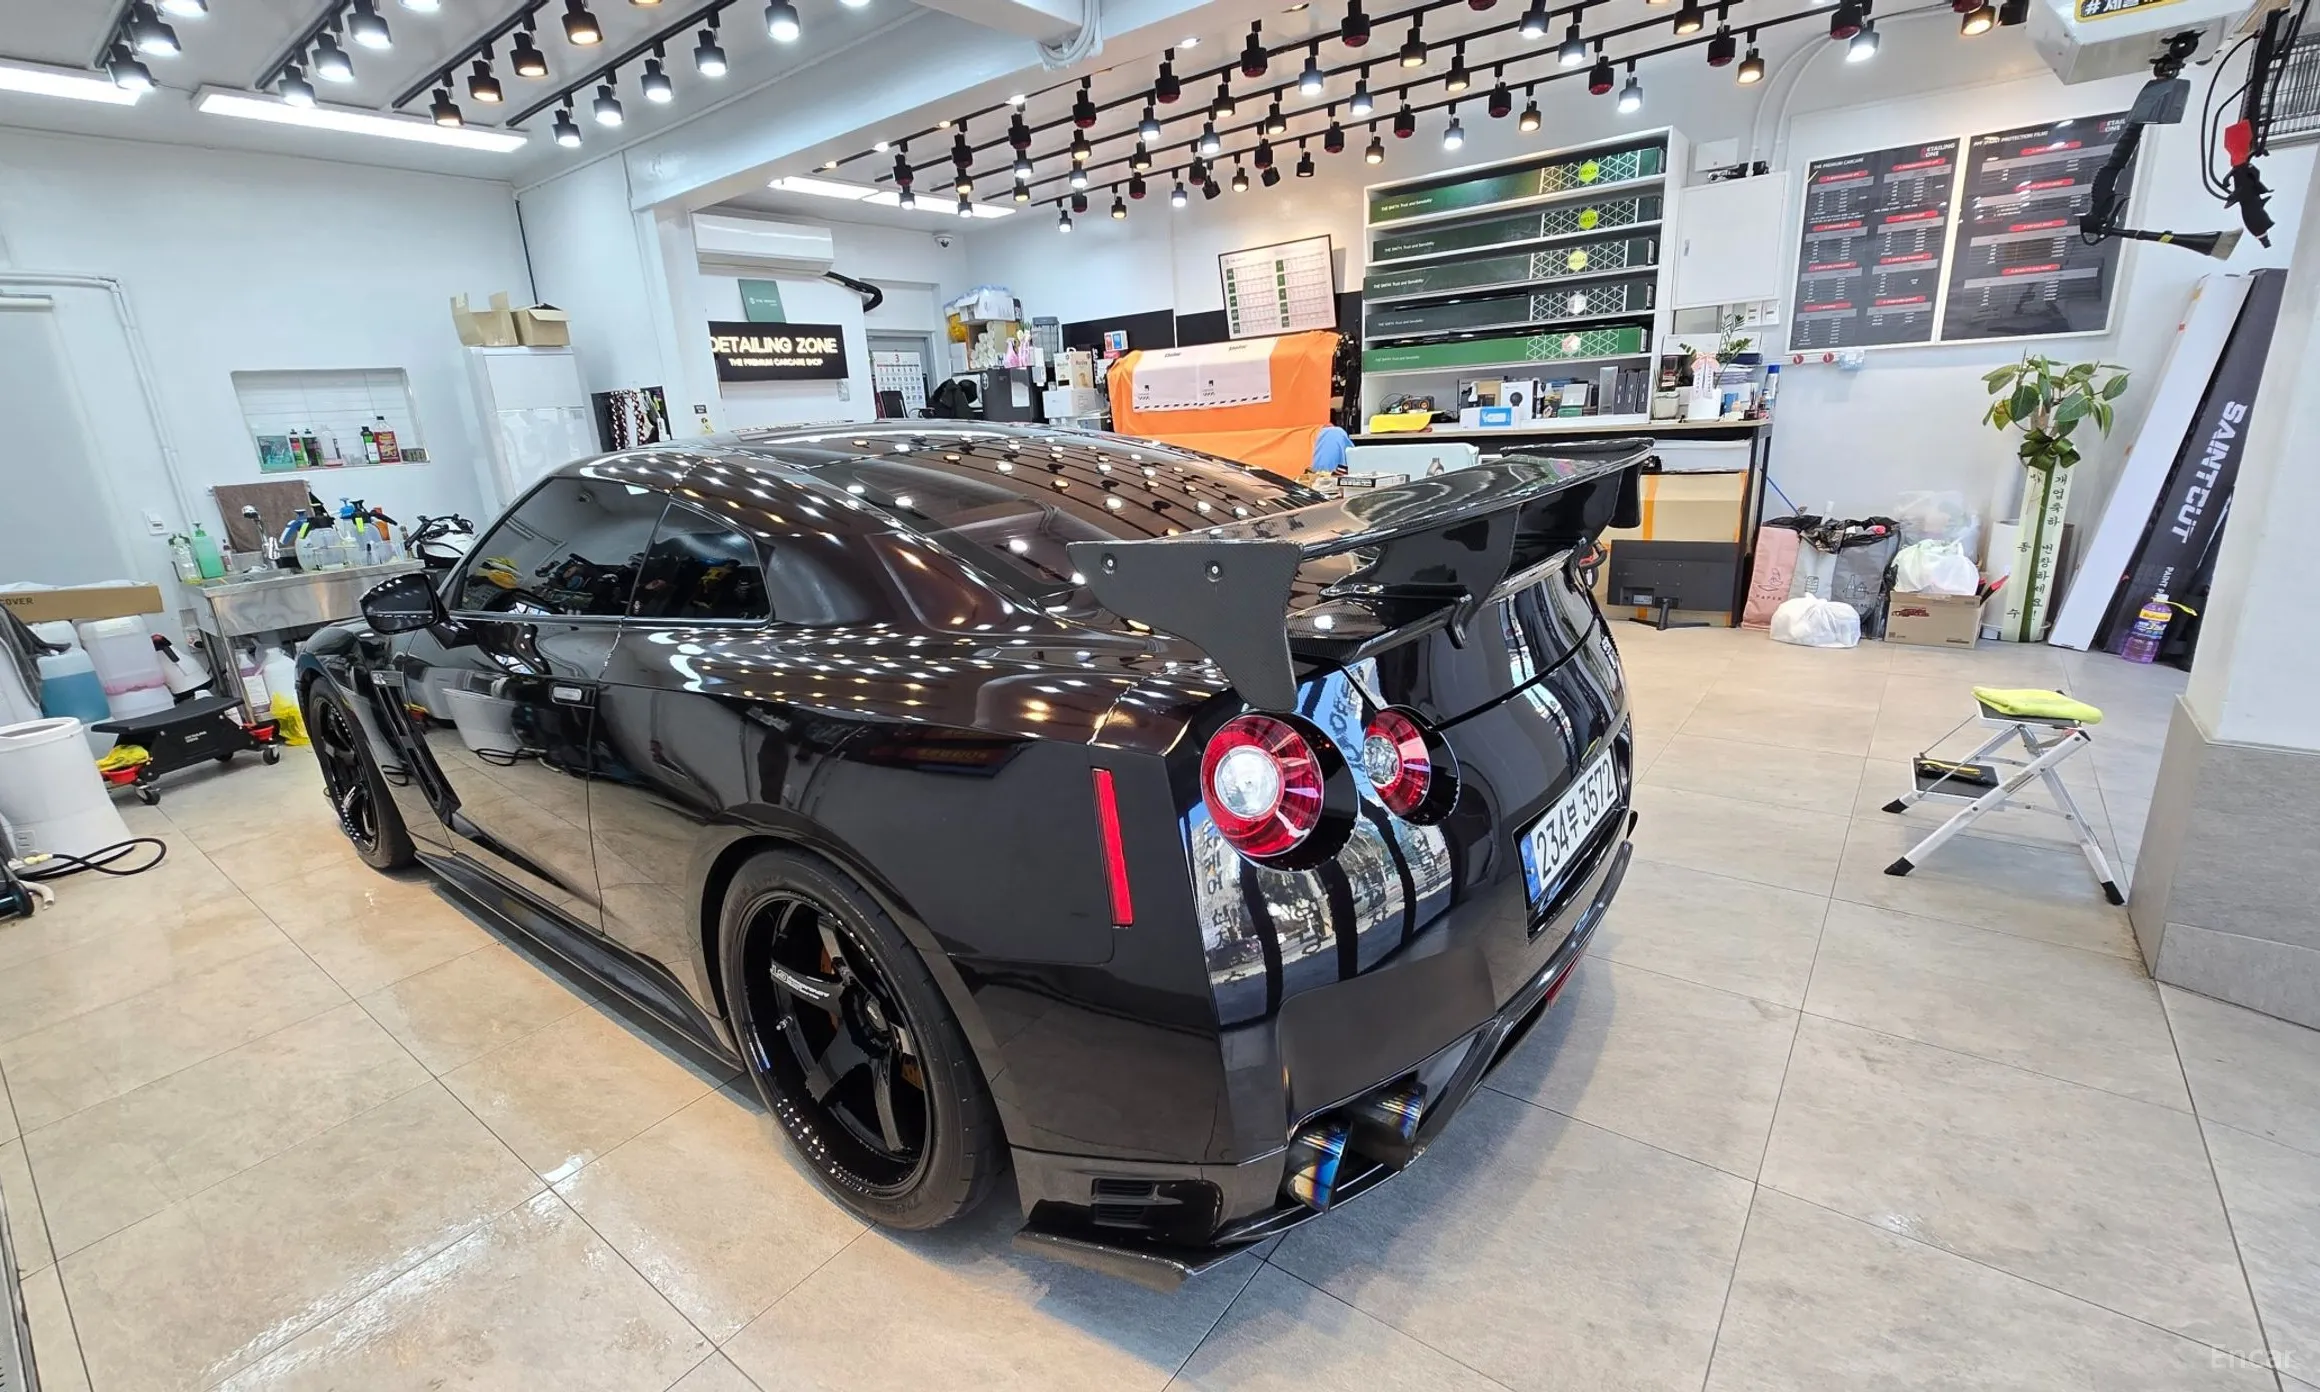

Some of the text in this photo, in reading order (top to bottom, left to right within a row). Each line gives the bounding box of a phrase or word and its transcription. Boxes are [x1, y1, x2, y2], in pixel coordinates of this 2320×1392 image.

[709, 336, 838, 354] DETAILING ZONE
[728, 358, 823, 367] THE PREMIUM CARCARE SHOP
[2171, 400, 2248, 544] SAINTCUT
[2159, 566, 2175, 588] PAINT
[0, 597, 35, 606] OVER
[1537, 760, 1614, 880] 234부 3572
